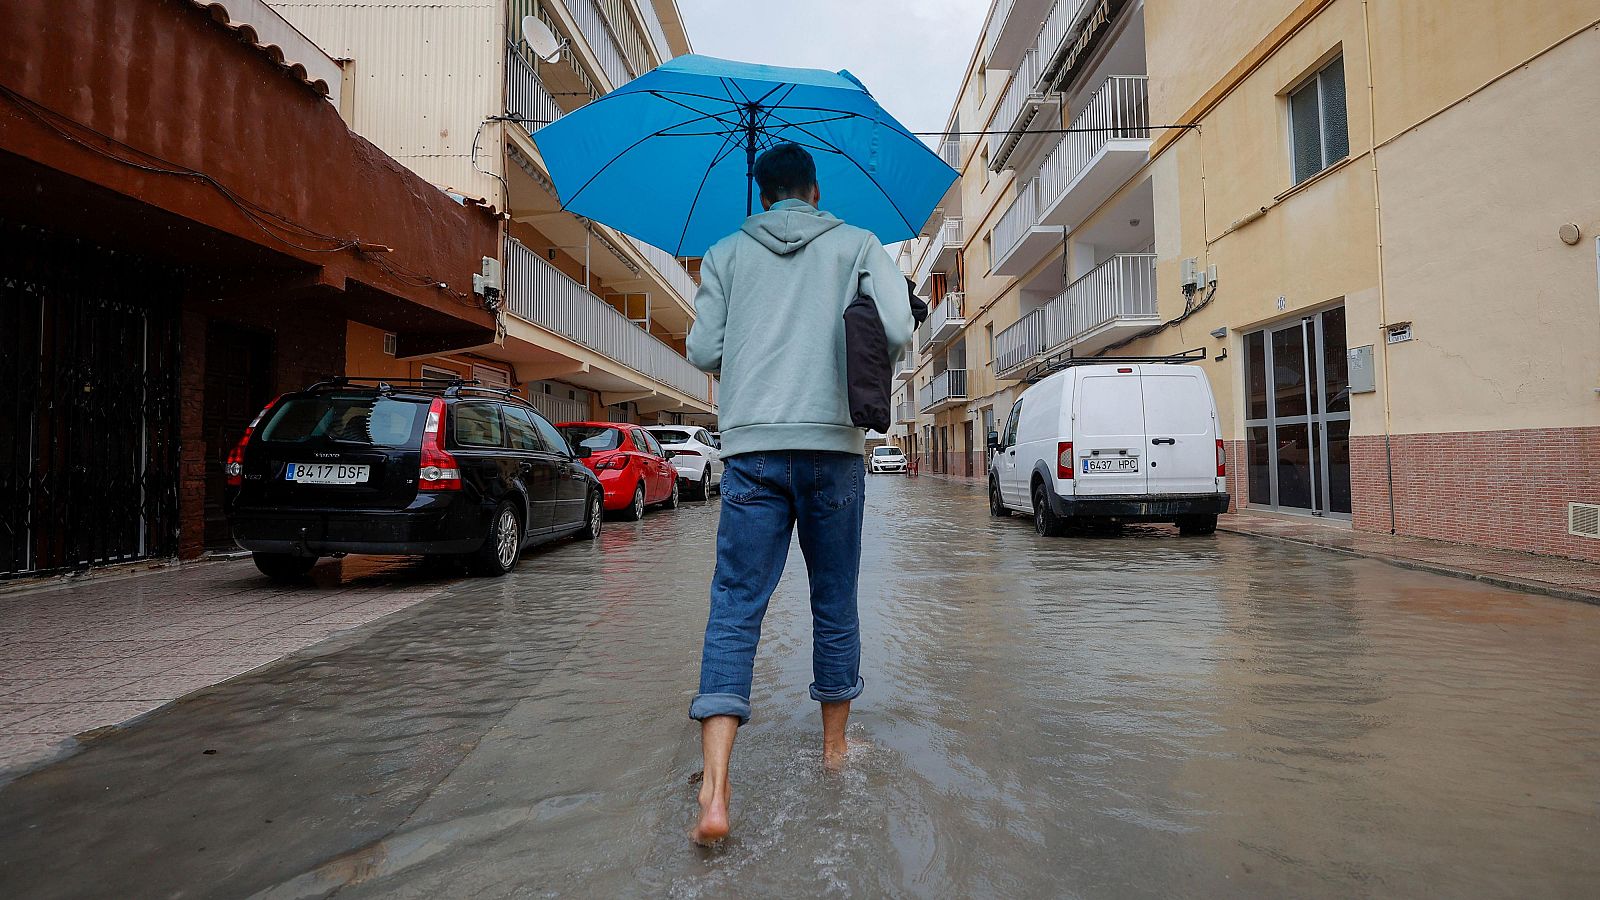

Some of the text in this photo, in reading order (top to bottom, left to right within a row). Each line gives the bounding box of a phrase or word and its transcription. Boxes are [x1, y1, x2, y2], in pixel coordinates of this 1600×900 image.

[1090, 459, 1136, 470] 6437 HPC
[297, 465, 366, 479] 8417 DSF
